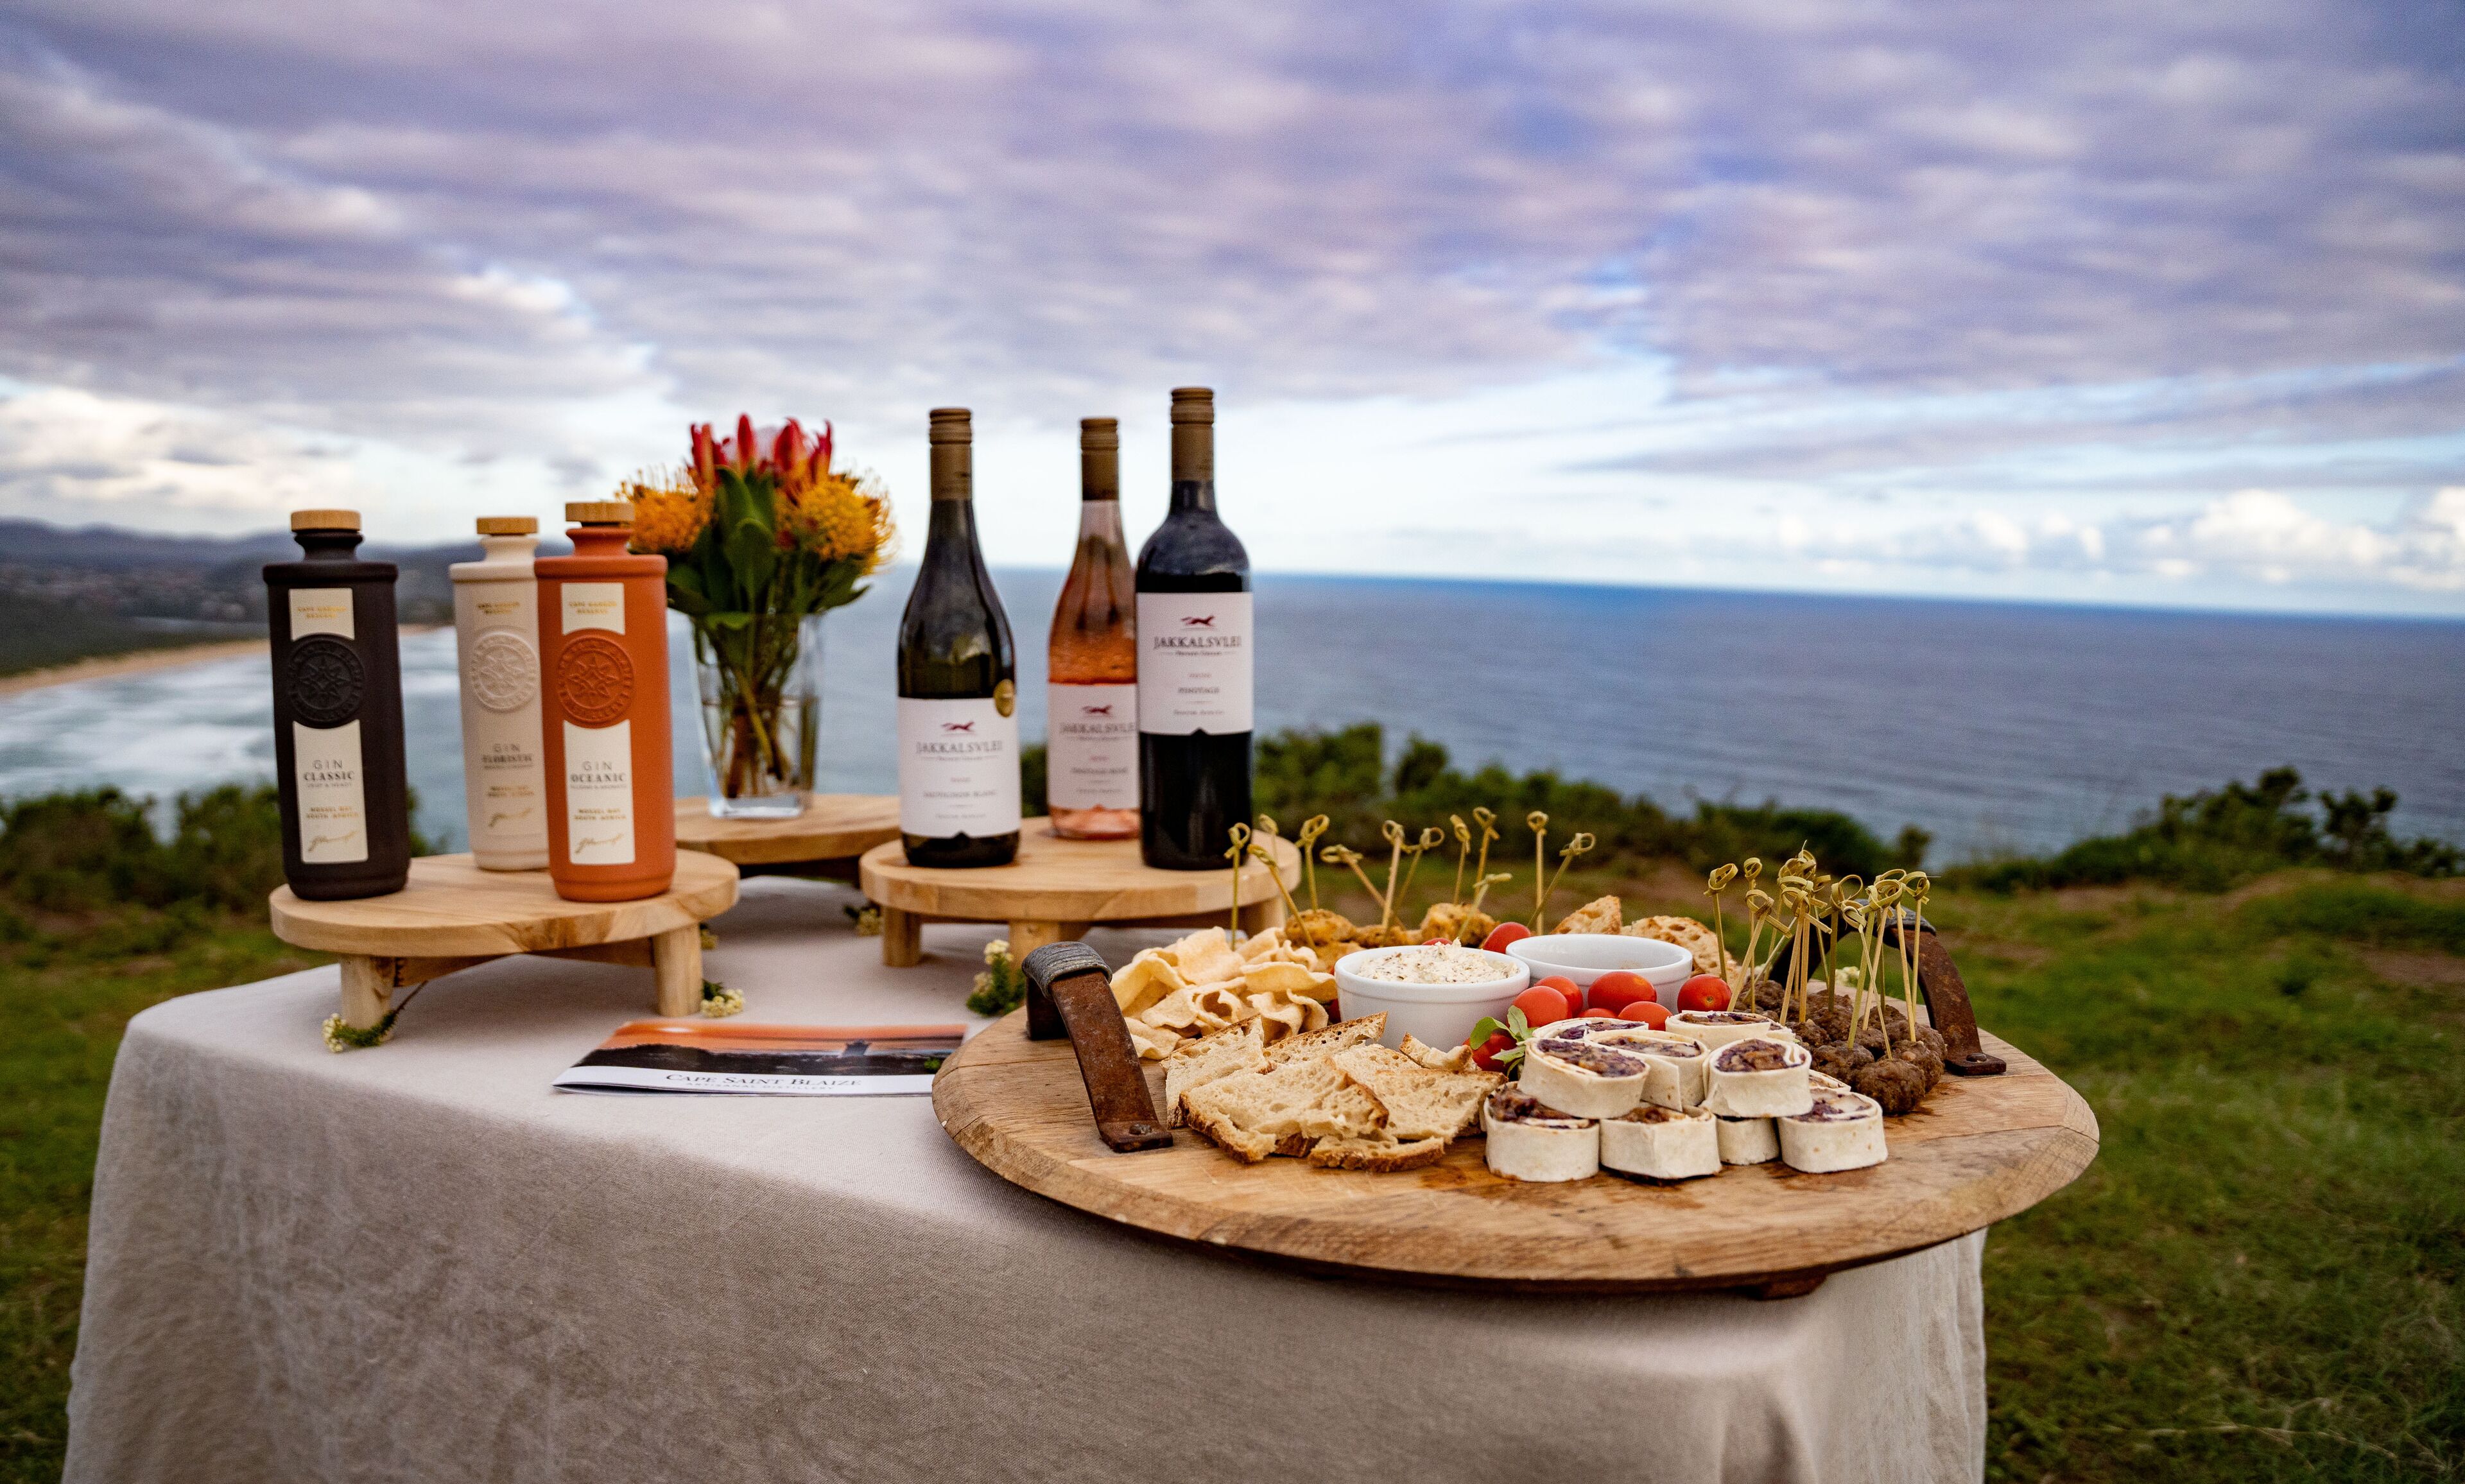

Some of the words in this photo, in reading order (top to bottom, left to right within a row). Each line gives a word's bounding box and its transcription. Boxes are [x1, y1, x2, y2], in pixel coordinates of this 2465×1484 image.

[1154, 635, 1241, 650] JAKKALSVLEI
[1060, 722, 1136, 733] JAKKALSVLE
[493, 743, 520, 752] GIN
[916, 739, 1003, 754] JAKKALSVLEI
[313, 759, 343, 770] GIN
[582, 761, 612, 771] GIN
[304, 771, 355, 781] CLASSIC
[571, 772, 626, 782] OCEANIC
[666, 1074, 717, 1082] CAPE
